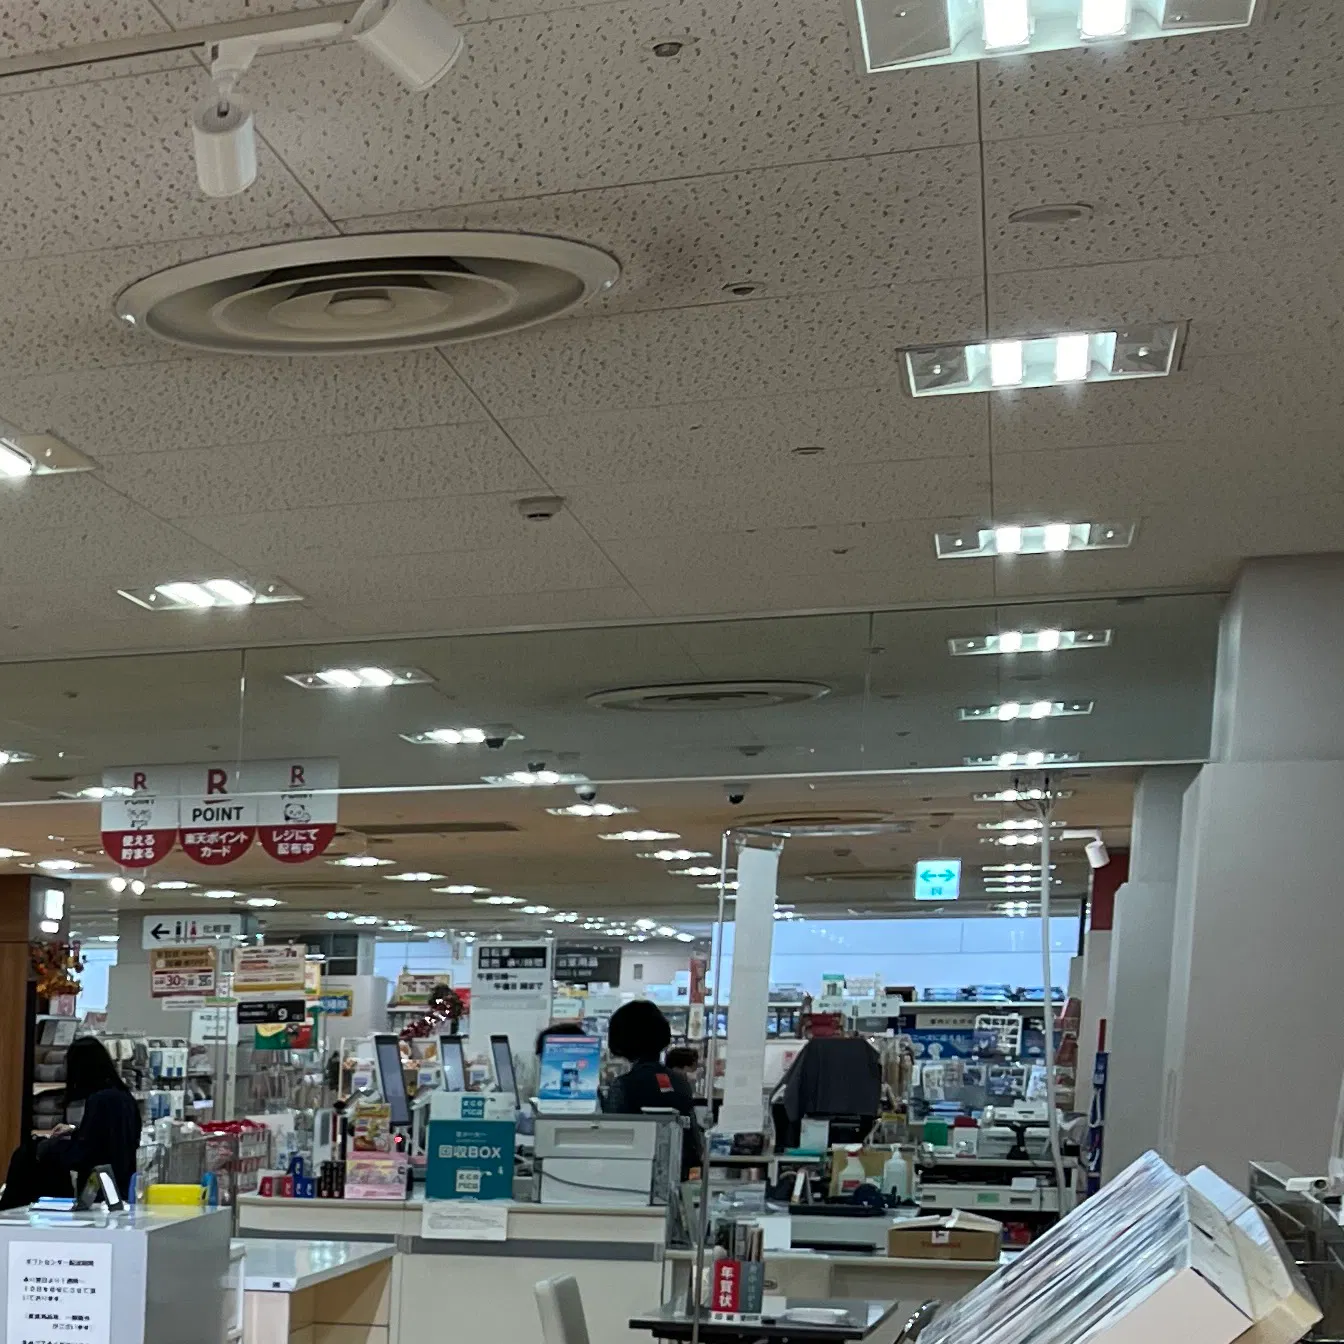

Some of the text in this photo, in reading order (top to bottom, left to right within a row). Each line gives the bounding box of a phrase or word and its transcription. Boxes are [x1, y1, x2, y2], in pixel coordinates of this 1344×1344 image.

[134, 772, 148, 790] R
[207, 769, 229, 795] R
[290, 765, 306, 787] R
[192, 807, 245, 822] POINT
[272, 829, 319, 842] レジにて
[200, 846, 232, 858] カード
[438, 1144, 502, 1160] 回収BOX
[718, 1264, 734, 1309] 年賀状
